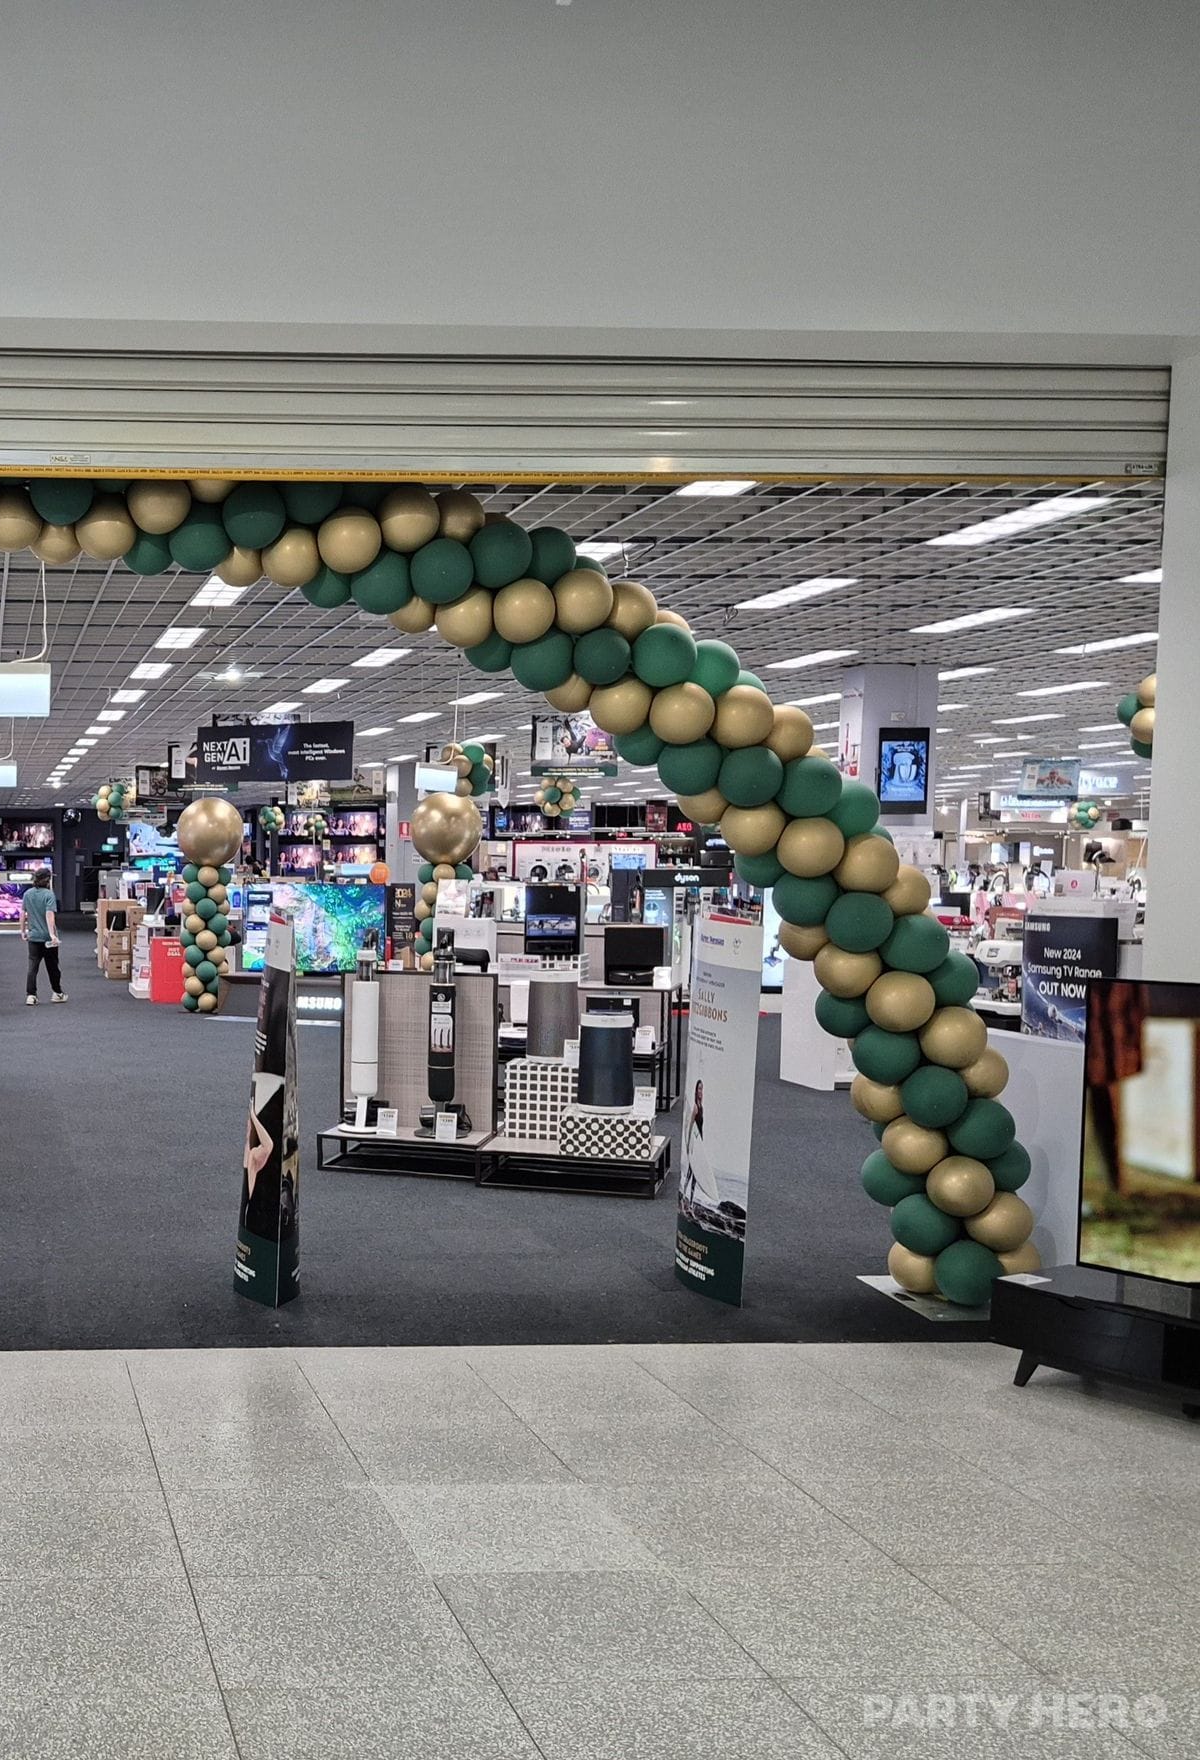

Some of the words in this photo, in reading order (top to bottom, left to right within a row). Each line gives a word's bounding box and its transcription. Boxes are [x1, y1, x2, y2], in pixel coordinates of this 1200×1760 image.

[203, 741, 228, 752] NEXT
[204, 753, 224, 763] GEN
[226, 740, 247, 762] Ai
[674, 873, 699, 884] dyson
[1025, 922, 1051, 932] SAMSUNG
[1044, 948, 1062, 959] New
[1063, 948, 1081, 960] 2024
[1028, 963, 1062, 979] Samsung
[1063, 965, 1073, 977] TV
[1075, 966, 1102, 978] Range
[1039, 982, 1059, 995] OUT
[1061, 983, 1086, 999] NOW
[297, 996, 342, 1010] MSUNG
